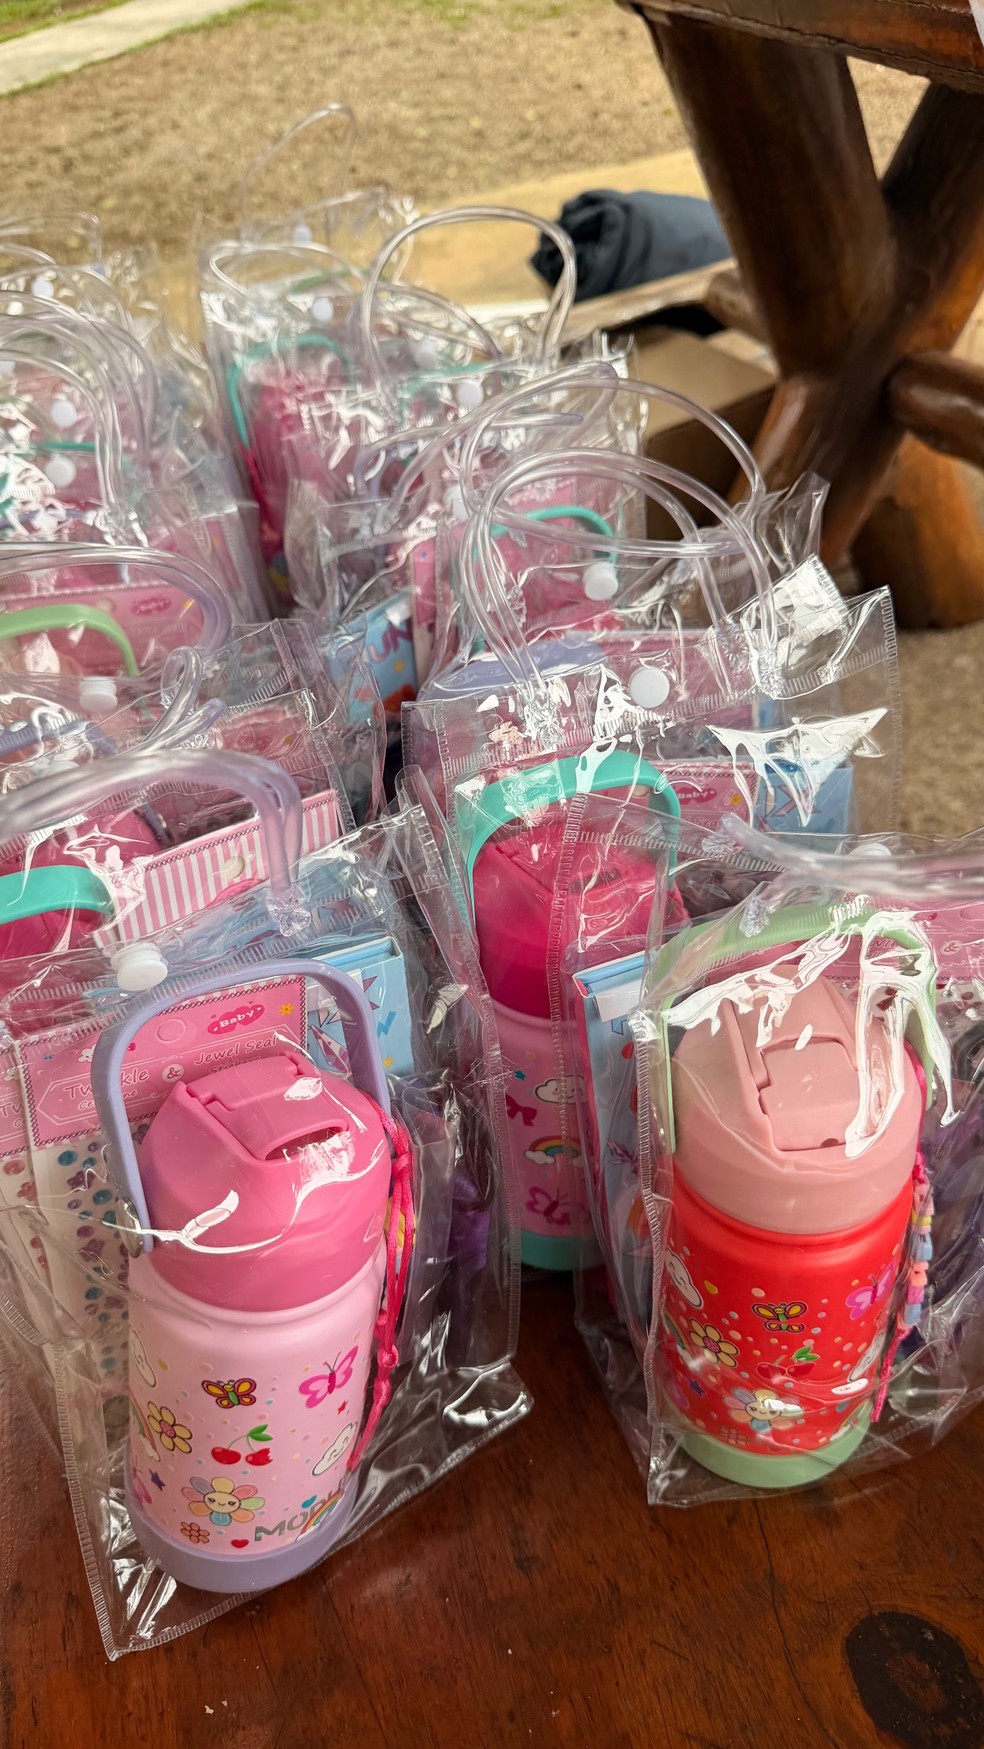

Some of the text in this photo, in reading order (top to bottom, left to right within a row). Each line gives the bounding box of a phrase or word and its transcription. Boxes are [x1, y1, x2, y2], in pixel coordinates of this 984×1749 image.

[219, 1010, 254, 1028] Baby
[63, 1067, 149, 1100] Twkle
[166, 1066, 182, 1079] &
[194, 1043, 240, 1066] Jewel
[245, 1032, 278, 1054] Seal
